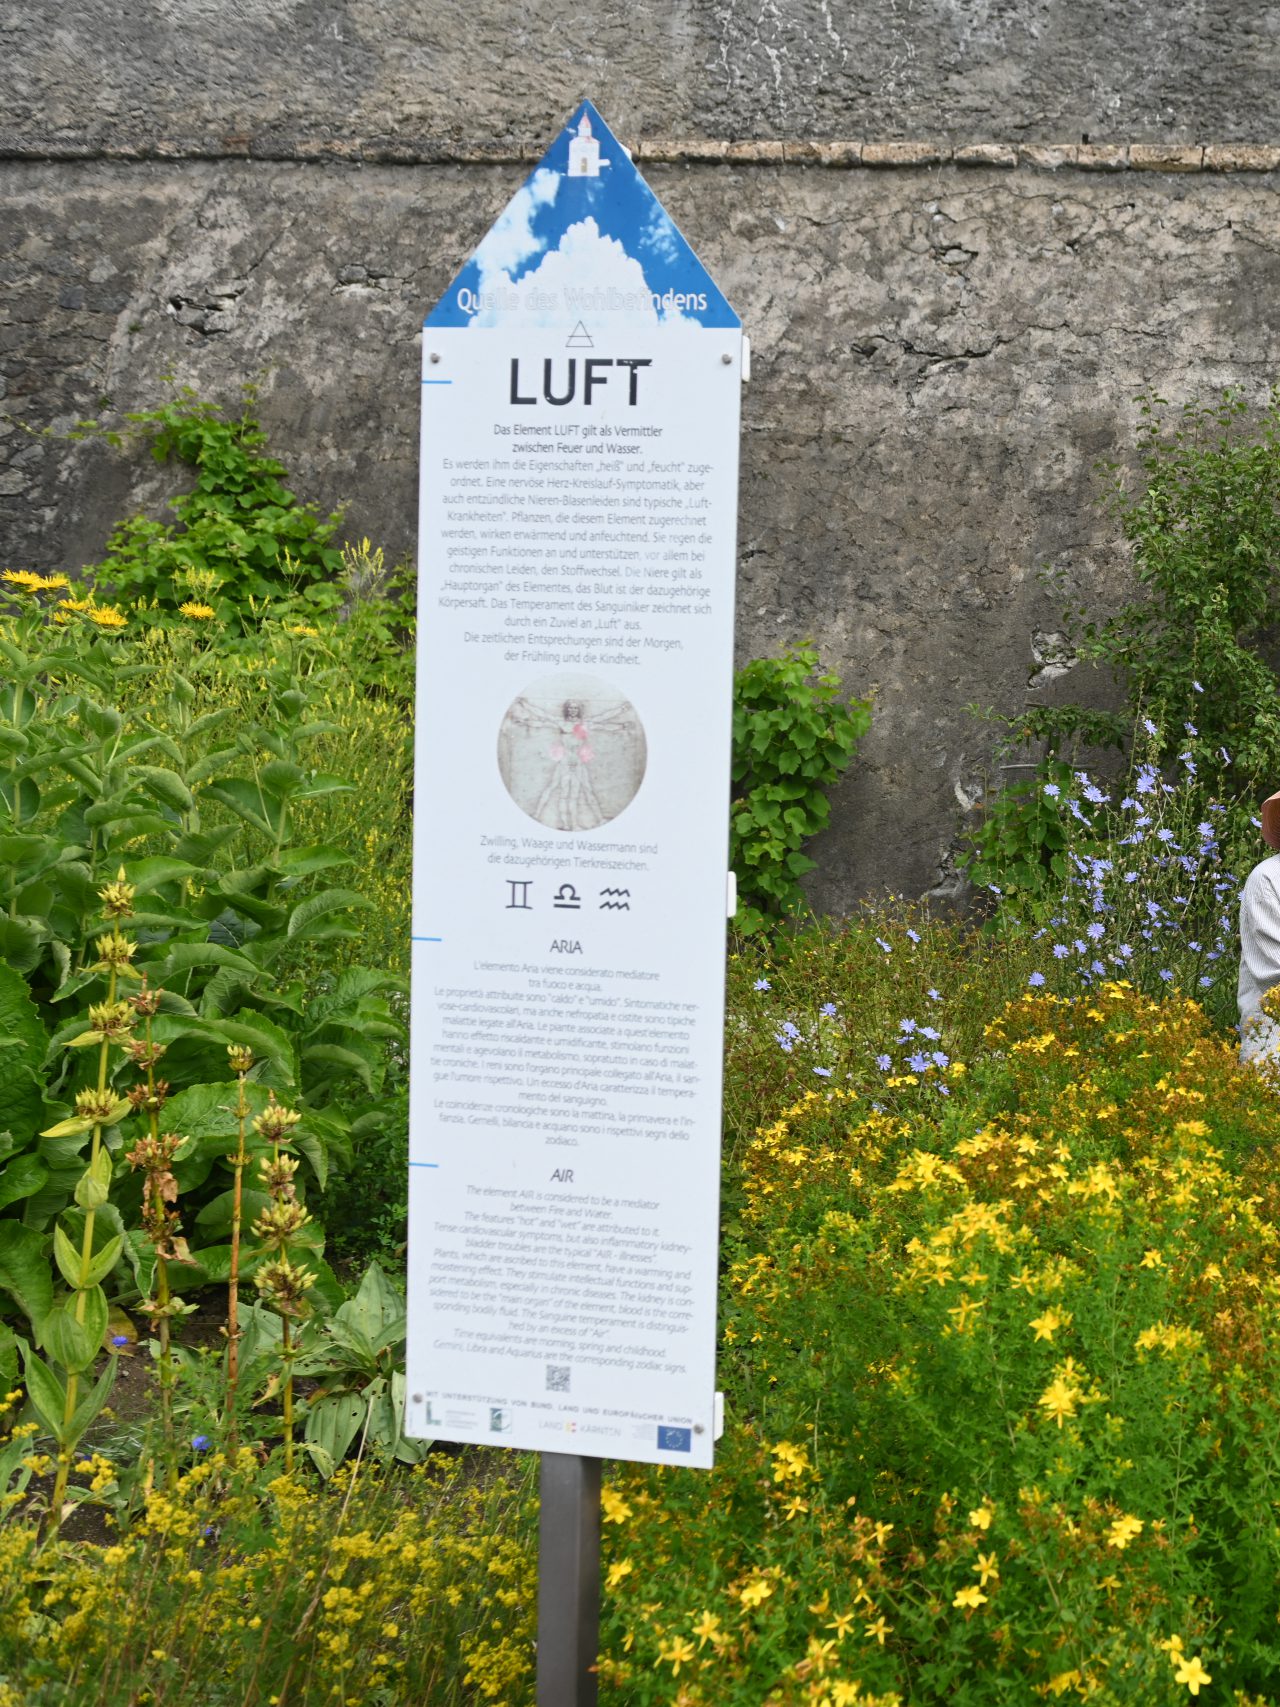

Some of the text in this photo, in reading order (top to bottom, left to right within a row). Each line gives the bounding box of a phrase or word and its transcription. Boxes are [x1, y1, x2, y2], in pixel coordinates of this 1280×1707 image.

[457, 287, 707, 314] Quelle des Wohlbefindens
[510, 358, 652, 406] LUFT
[493, 424, 663, 439] Das Element LUFT gilt als Vermittler
[512, 443, 555, 453] zwischen
[556, 442, 583, 454] Feuer
[585, 444, 604, 454] und
[442, 458, 454, 469] Es
[455, 460, 491, 470] werden
[492, 459, 511, 470] ihm
[512, 459, 527, 470] die
[528, 459, 594, 475] Eigenschaften
[626, 462, 646, 472] und
[485, 476, 507, 488] Eine
[508, 478, 545, 488] nervöse
[683, 481, 705, 491] aber
[442, 494, 465, 504] auch
[466, 493, 526, 505] entzündliche
[527, 494, 621, 507] Nieren-Blasenleiden
[622, 496, 642, 507] sind
[643, 497, 683, 512] typische
[555, 511, 570, 524] die
[571, 514, 605, 524] diesem
[606, 513, 647, 525] Element
[648, 515, 707, 530] zugerechnet
[479, 528, 512, 540] wirken
[513, 530, 568, 541] erwärmend
[568, 530, 588, 542] und
[652, 531, 667, 543] Sie
[668, 533, 696, 547] regen
[697, 532, 713, 544] die
[446, 546, 488, 559] geistigen
[489, 545, 544, 558] Funktionen
[544, 548, 558, 558] an
[558, 548, 578, 559] und
[644, 551, 660, 561] vor
[662, 550, 689, 561] allem
[690, 550, 706, 562] bei
[448, 563, 504, 575] chronischen
[540, 565, 559, 576] den
[624, 566, 641, 578] Die
[643, 567, 670, 578] Niere
[670, 567, 687, 582] gilt
[689, 567, 703, 579] als
[504, 581, 521, 592] des
[575, 582, 592, 594] das
[593, 582, 614, 594] Blut
[615, 583, 627, 595] ist
[628, 584, 645, 595] der
[646, 584, 711, 601] dazugehörige
[490, 597, 508, 609] Das
[510, 598, 575, 613] Temperament
[576, 600, 593, 612] des
[594, 600, 650, 616] Sanguiniker
[651, 603, 692, 614] zeichnet
[693, 603, 712, 615] sich
[504, 615, 532, 627] durch
[532, 616, 548, 627] ein
[549, 616, 579, 629] Zuviel
[579, 619, 593, 629] an
[463, 631, 480, 643] Die
[481, 632, 526, 644] zeitlichen
[527, 633, 603, 650] Entsprechungen
[604, 635, 625, 647] sind
[625, 637, 641, 648] der
[504, 650, 520, 661] der
[521, 650, 561, 665] Frühling
[562, 653, 582, 663] und
[582, 652, 597, 664] die
[521, 837, 554, 852] Waage
[555, 839, 575, 850] und
[576, 840, 637, 854] Wassermann
[638, 843, 659, 855] sind
[487, 852, 502, 864] die
[503, 853, 572, 870] dazugehörigen
[549, 938, 584, 955] ARIA
[550, 1167, 574, 1183] AIR
